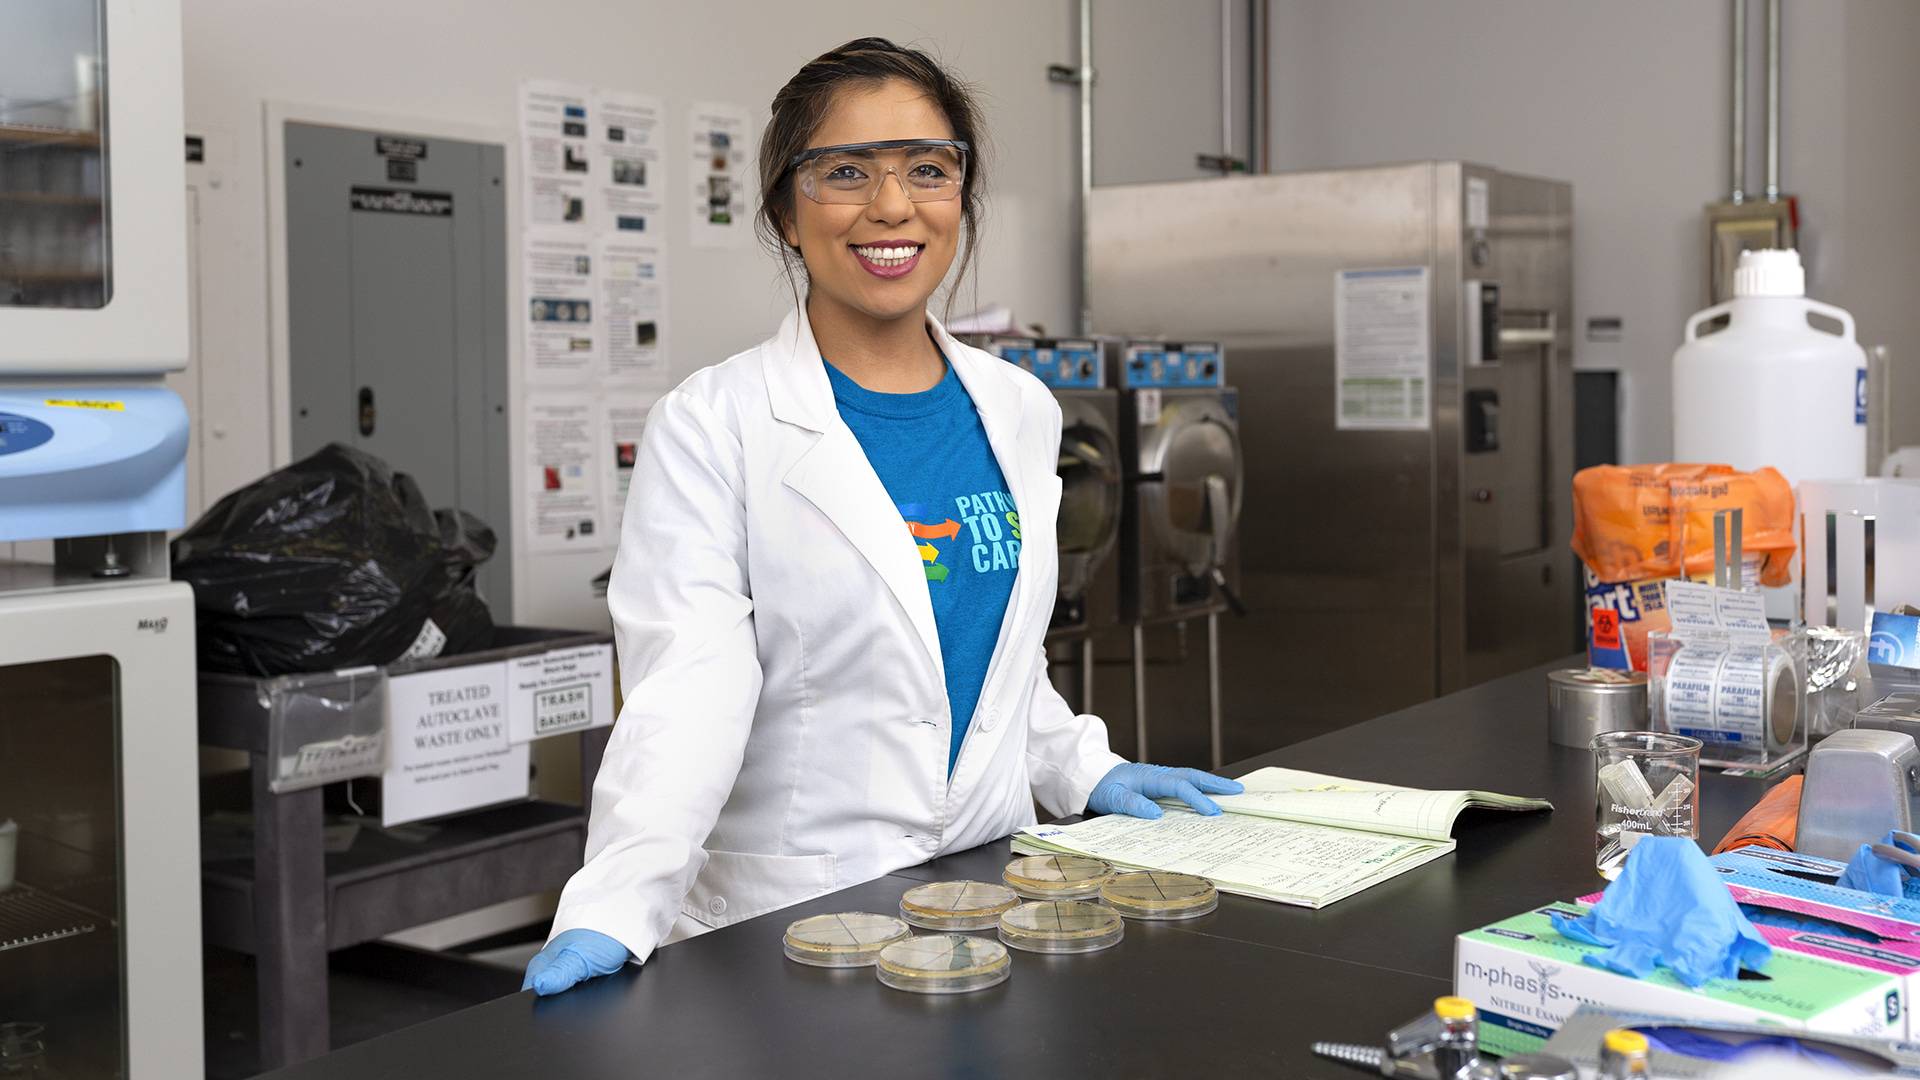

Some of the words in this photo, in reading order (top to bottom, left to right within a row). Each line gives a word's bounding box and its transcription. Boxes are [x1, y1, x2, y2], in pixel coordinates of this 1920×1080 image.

[963, 513, 1003, 544] TO
[428, 685, 491, 706] TREATED
[1672, 681, 1710, 694] PARAFILM
[1721, 686, 1761, 697] PARAFILM
[541, 691, 585, 707] TRASH
[417, 703, 499, 729] AUTOCLAVE
[540, 710, 587, 727] BASURA
[414, 730, 461, 749] WASTE
[463, 722, 501, 743] ONLY
[1621, 820, 1652, 831] 400mL
[1490, 996, 1531, 1016] NITRILE
